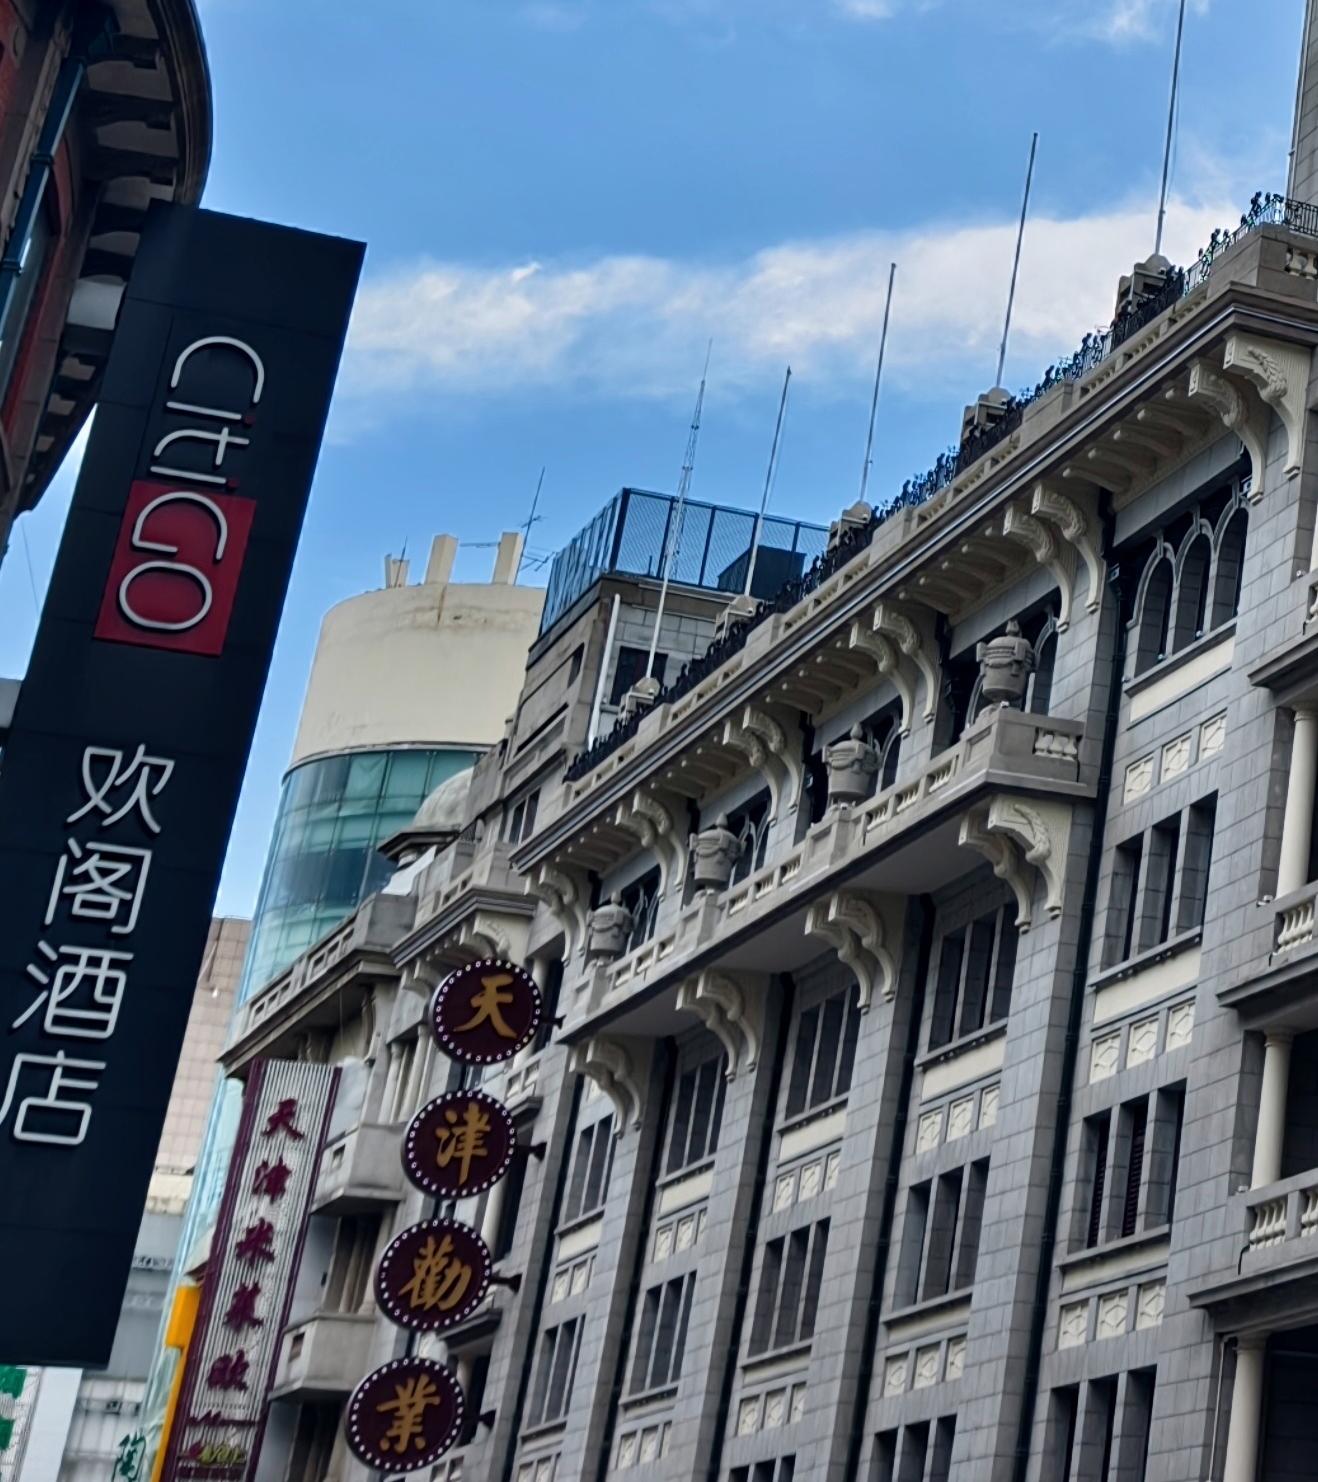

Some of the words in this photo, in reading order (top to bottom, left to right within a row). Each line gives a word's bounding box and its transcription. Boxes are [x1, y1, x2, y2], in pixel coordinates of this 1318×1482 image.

[119, 336, 265, 630] CitiGO
[0, 744, 176, 1146] 欢阁酒店
